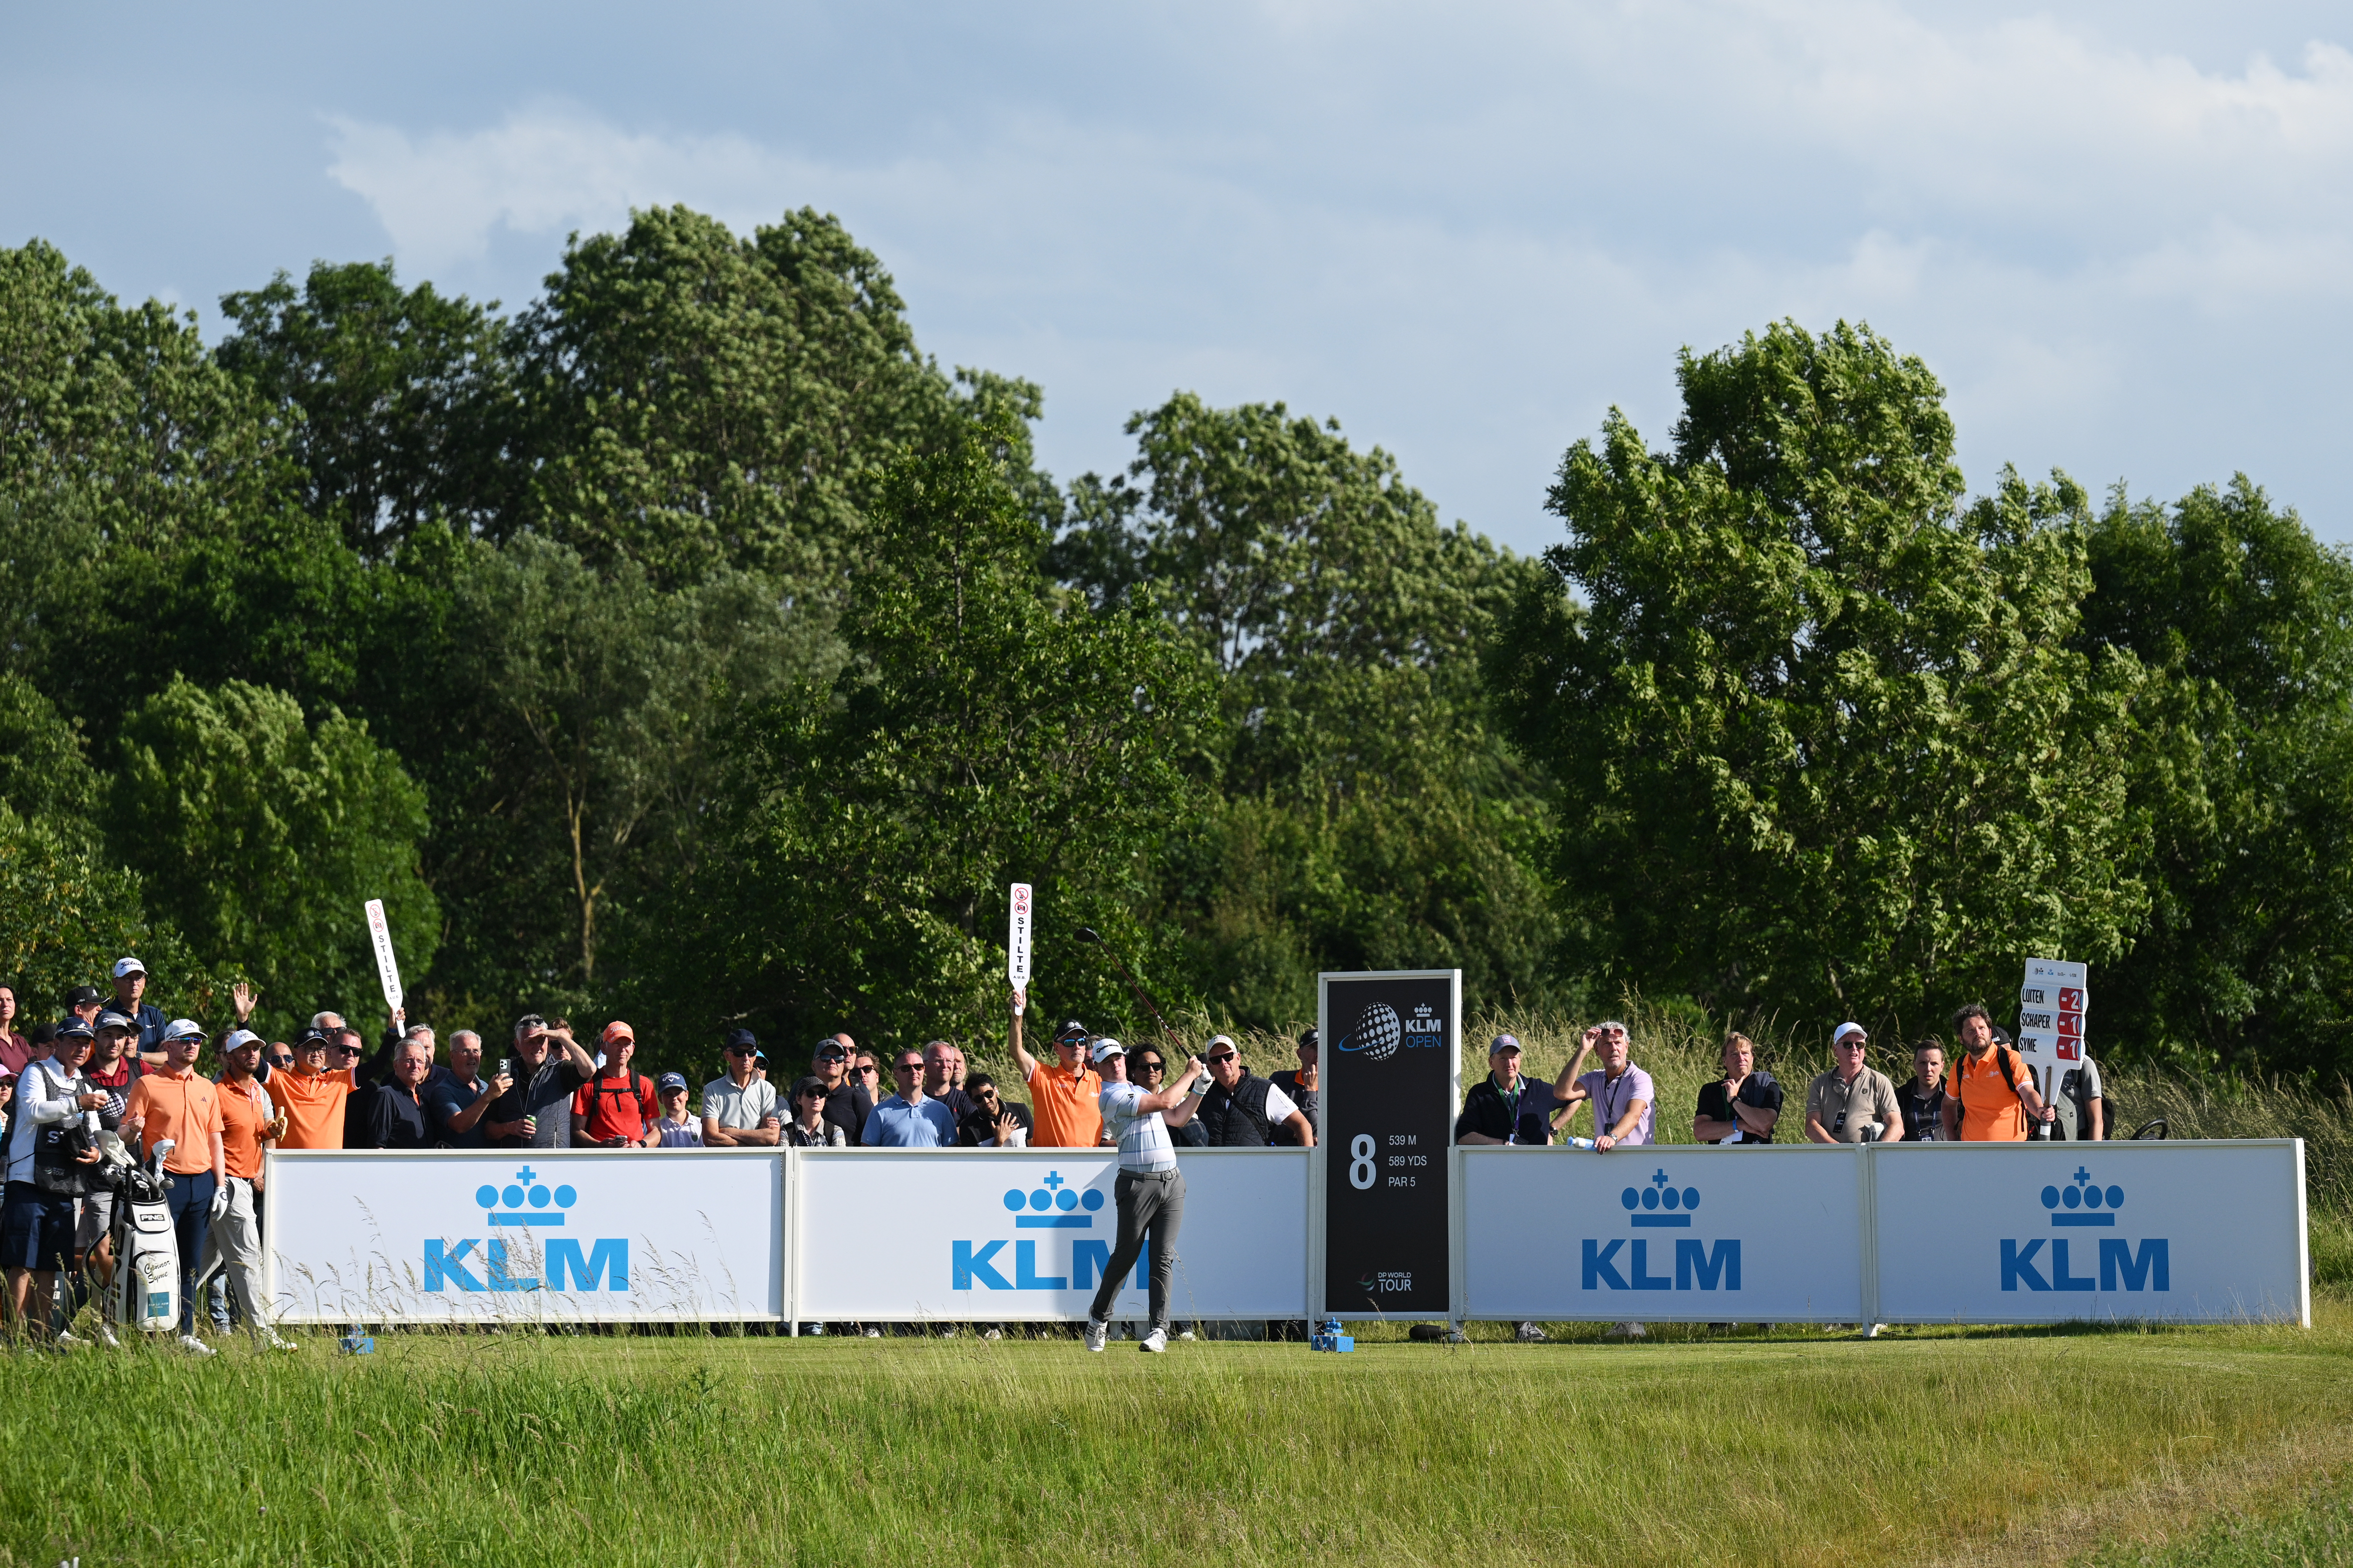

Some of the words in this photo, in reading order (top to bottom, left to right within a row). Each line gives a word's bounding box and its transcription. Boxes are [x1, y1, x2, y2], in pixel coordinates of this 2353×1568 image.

[378, 935, 396, 993] STILTE
[2022, 988, 2045, 1004] LUITEN
[1405, 1019, 1441, 1033] KLM
[2021, 1012, 2051, 1029] SCHAPER
[1406, 1035, 1441, 1047] OPEN
[2020, 1037, 2037, 1053] SYME
[662, 1073, 680, 1082] Callaway
[1389, 1135, 1405, 1145] 539
[1408, 1135, 1417, 1145] M
[1349, 1133, 1377, 1190] 8
[1389, 1156, 1405, 1166] 589
[1408, 1155, 1427, 1166] YDS
[1388, 1177, 1408, 1187] PAR
[1410, 1177, 1416, 1187] 5
[144, 1260, 171, 1275] Connor
[424, 1239, 628, 1292] KLM
[1582, 1239, 1741, 1290] KLM
[2000, 1239, 2169, 1291] KLM
[148, 1271, 169, 1284] Syme
[1378, 1279, 1412, 1294] TOUR
